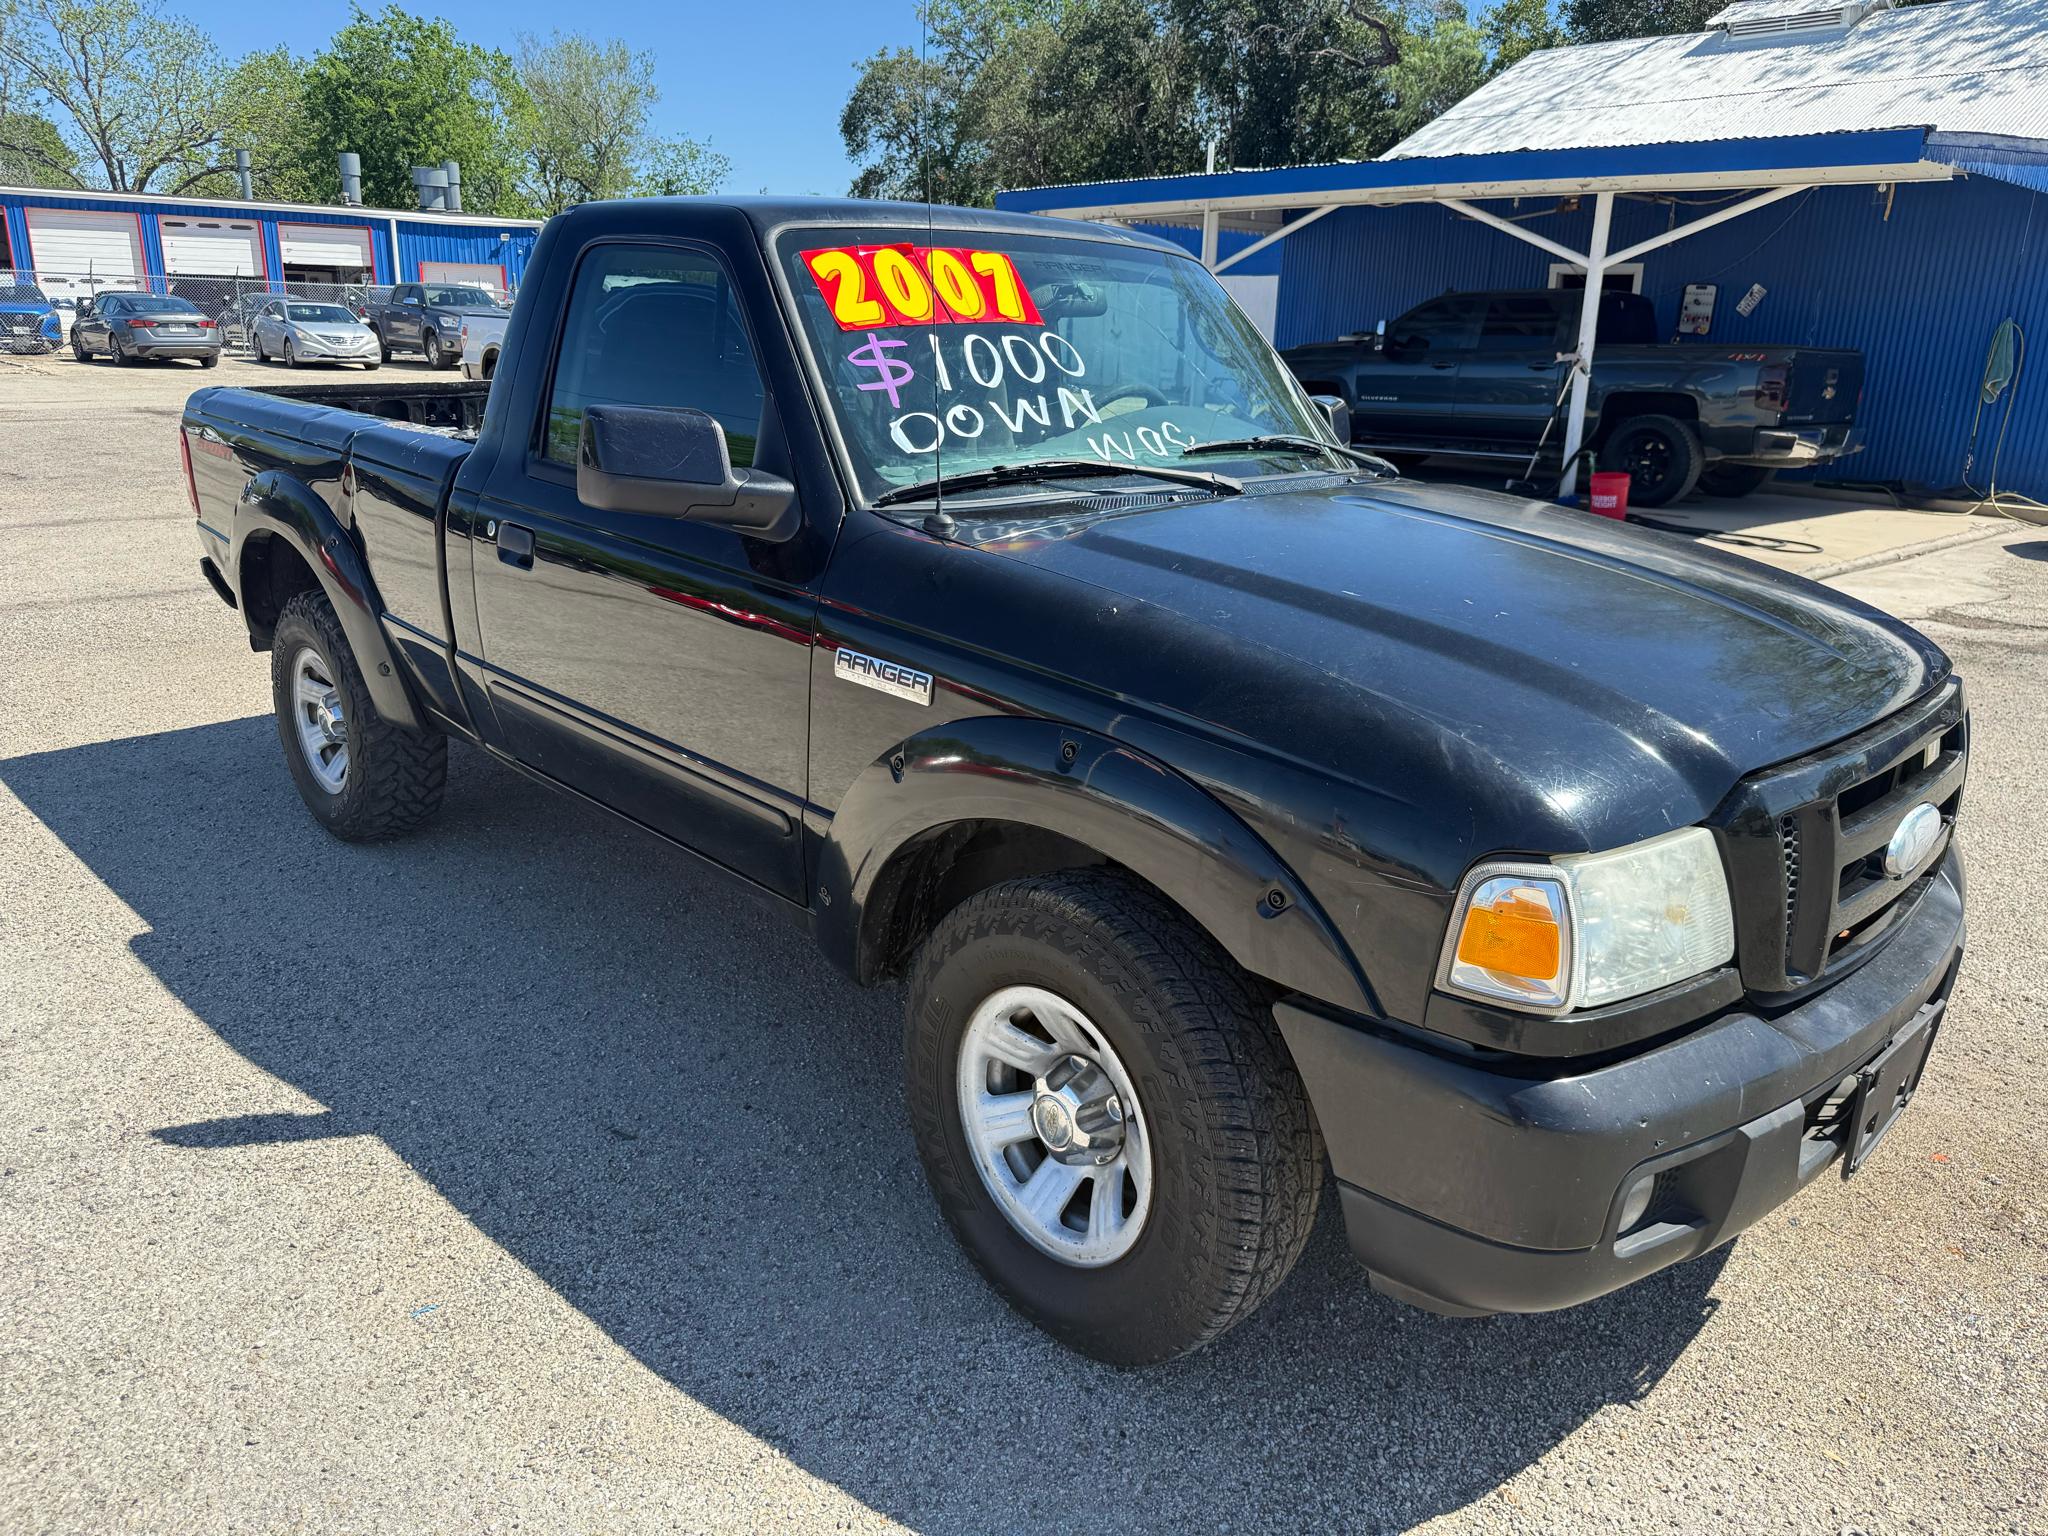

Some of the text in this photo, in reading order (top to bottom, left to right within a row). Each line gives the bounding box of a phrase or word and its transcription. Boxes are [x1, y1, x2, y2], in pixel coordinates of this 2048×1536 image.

[811, 247, 1026, 325] 2007
[889, 386, 1103, 455] DOWN
[837, 650, 930, 694] RANGER
